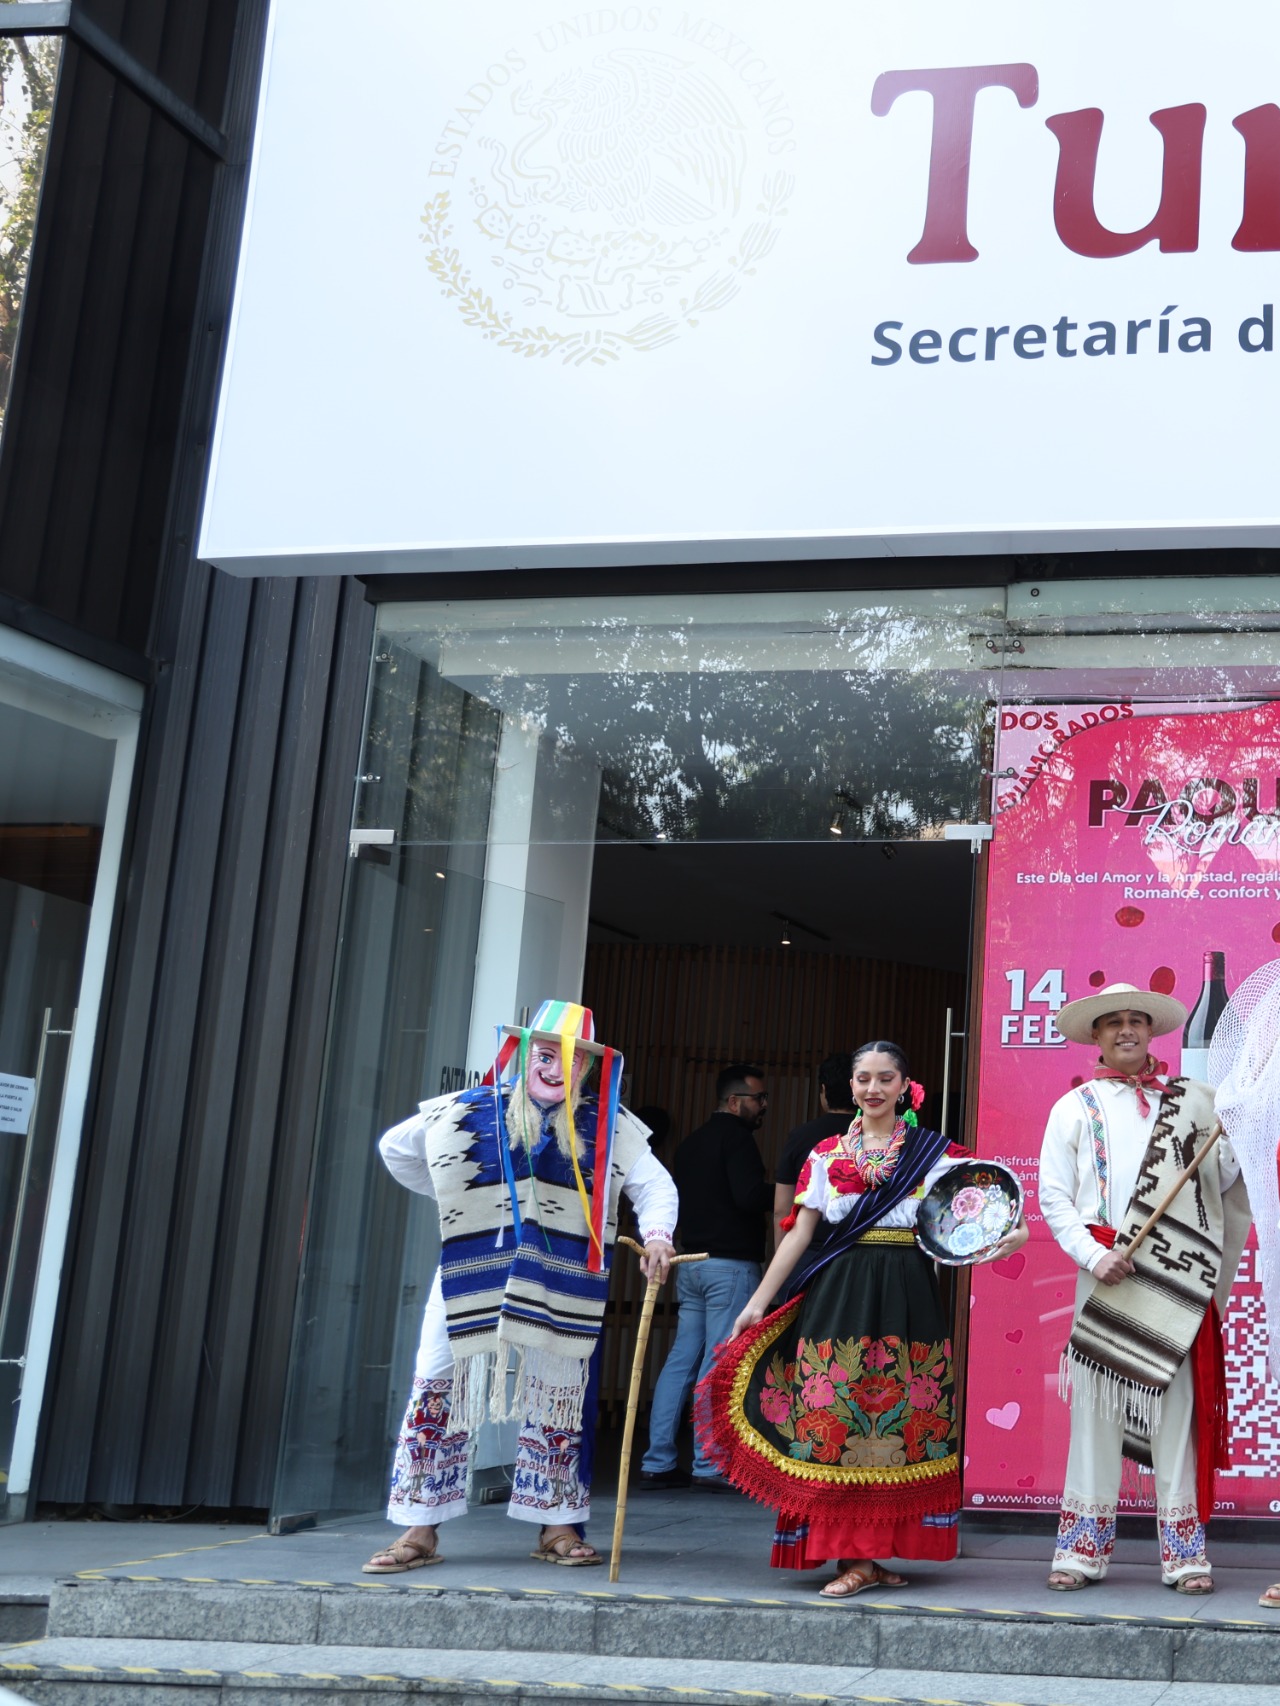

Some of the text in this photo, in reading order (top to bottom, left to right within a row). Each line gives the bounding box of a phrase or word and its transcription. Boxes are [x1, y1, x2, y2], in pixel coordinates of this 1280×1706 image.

[428, 5, 797, 179] ESTADOS UNIDOS MEXICANOS
[871, 304, 1211, 366] Secretaría
[1001, 711, 1058, 730] DOS
[1017, 872, 1045, 883] Este
[1075, 872, 1098, 883] del
[1102, 872, 1141, 883] Amor
[1146, 873, 1154, 886] y
[1158, 872, 1170, 883] la
[1124, 887, 1204, 900] Romance,
[1208, 886, 1270, 899] confort
[1005, 969, 1067, 1011] 14
[1001, 1015, 1067, 1044] FEB
